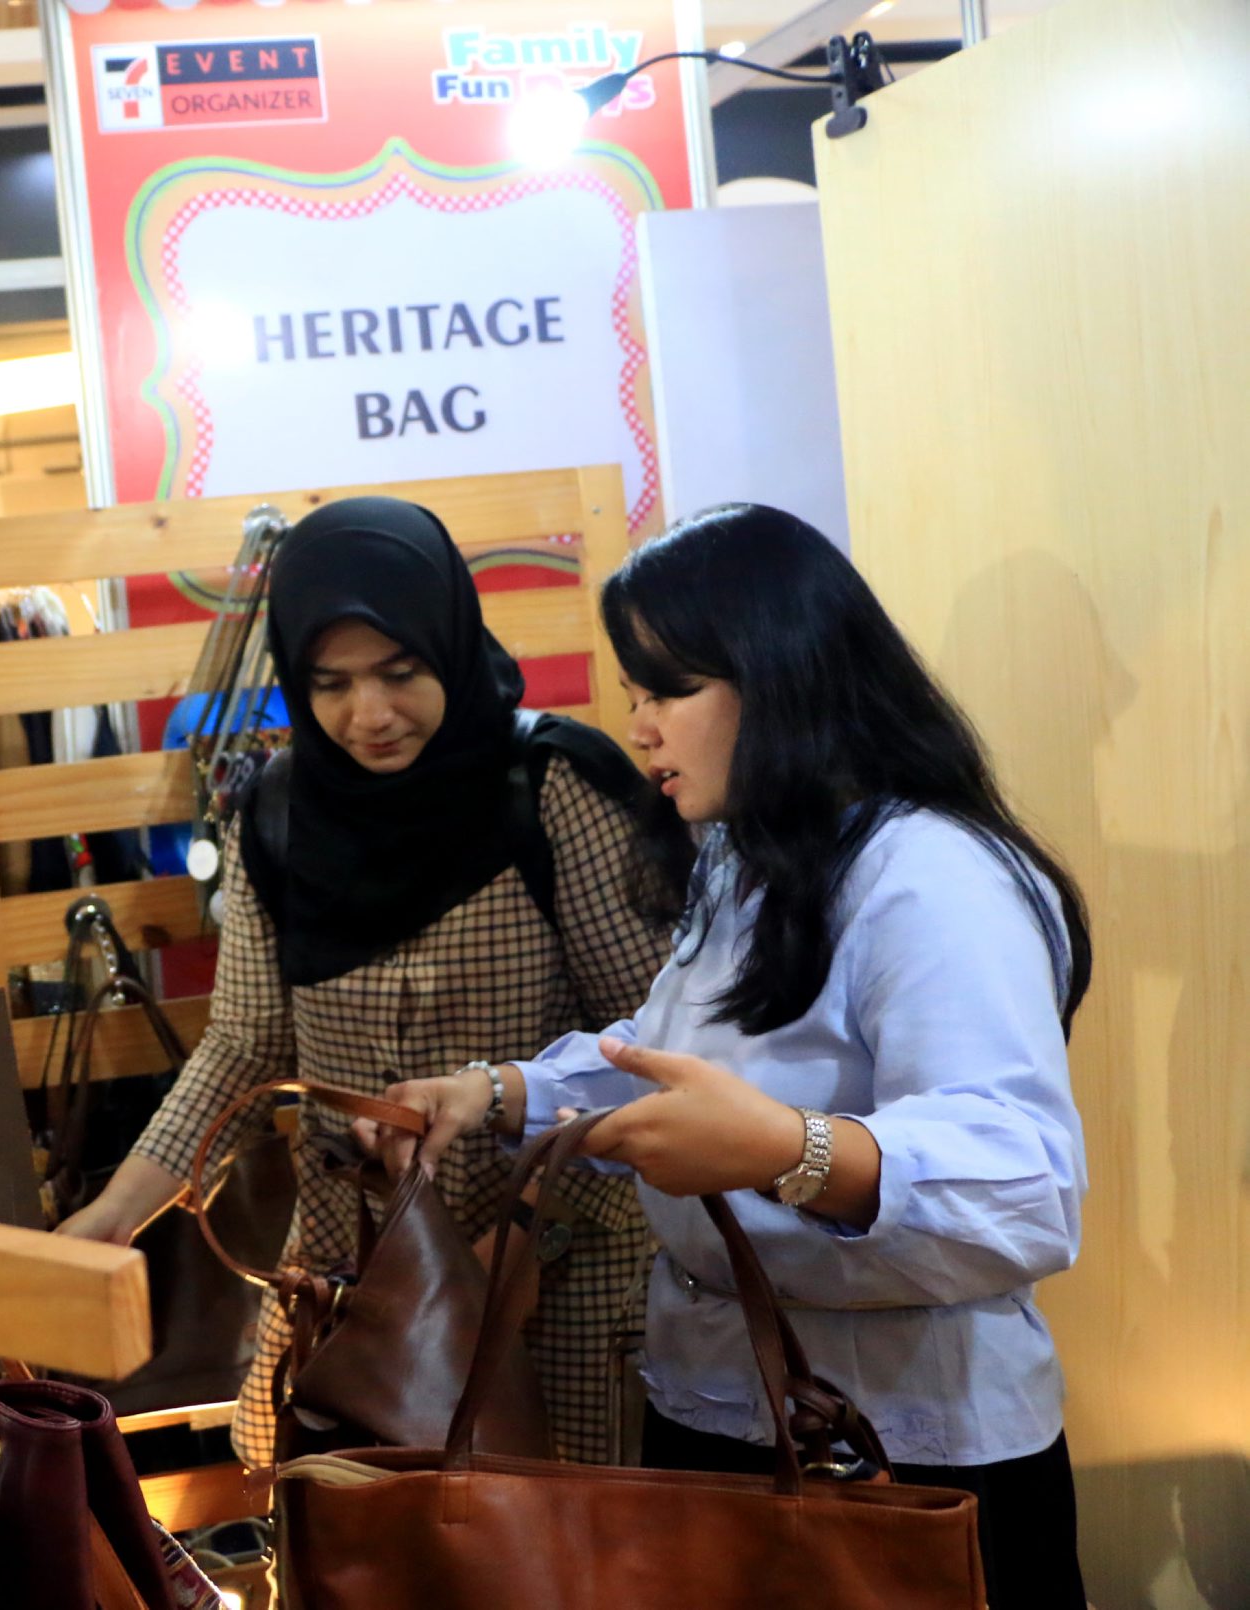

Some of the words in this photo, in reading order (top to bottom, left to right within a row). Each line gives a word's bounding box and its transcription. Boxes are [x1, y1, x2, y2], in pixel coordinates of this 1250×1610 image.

[166, 47, 308, 75] EVENT
[448, 28, 638, 68] Family
[107, 86, 153, 100] SEVEN
[437, 74, 510, 99] Fun
[171, 90, 313, 114] ORGANIZER
[253, 296, 565, 363] HERITAGE
[355, 384, 486, 440] BAG
